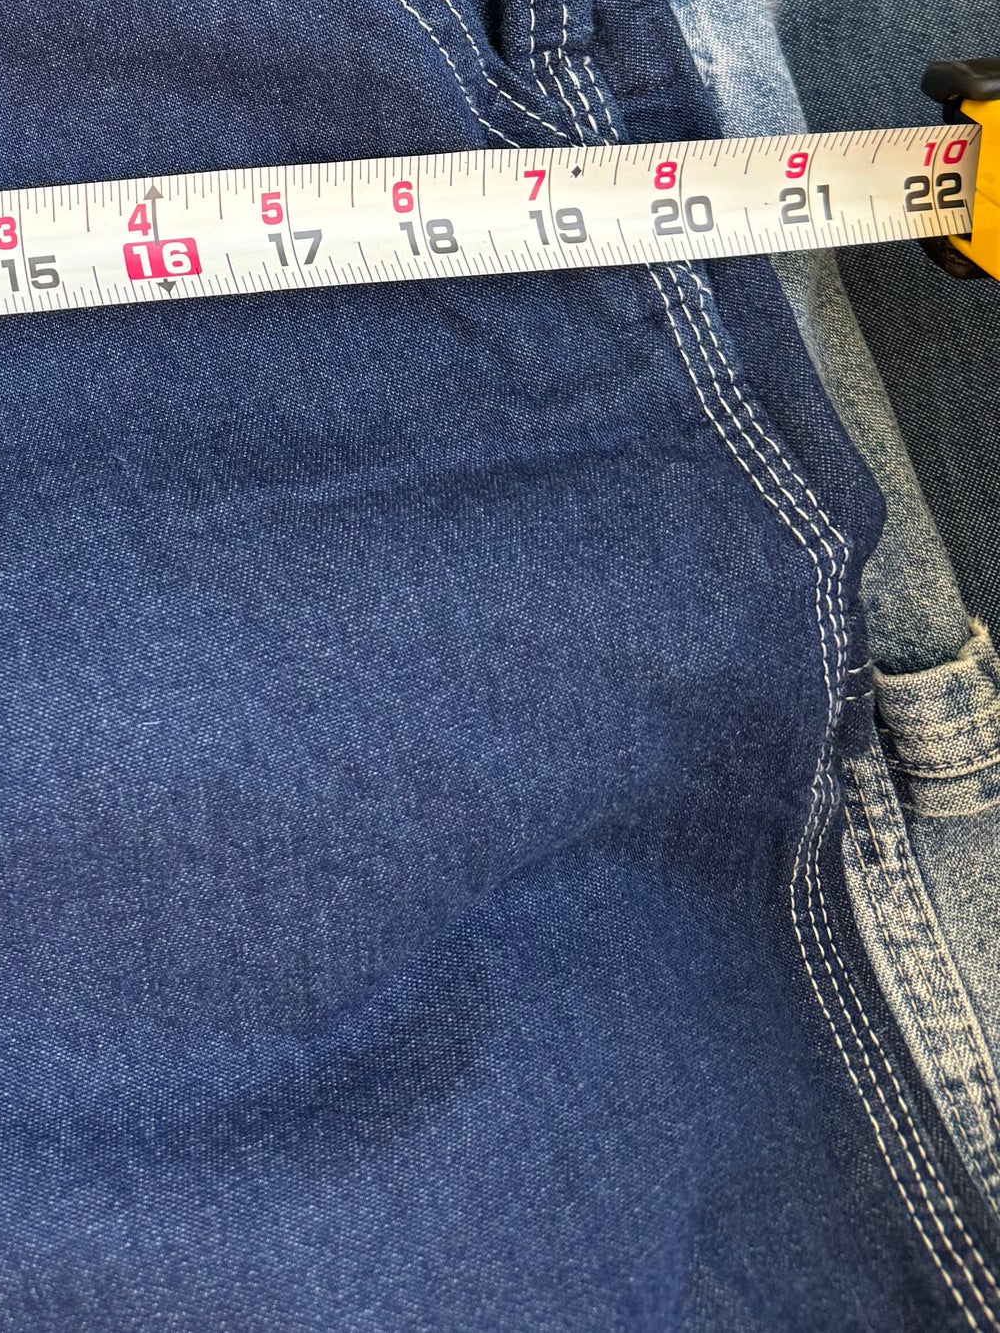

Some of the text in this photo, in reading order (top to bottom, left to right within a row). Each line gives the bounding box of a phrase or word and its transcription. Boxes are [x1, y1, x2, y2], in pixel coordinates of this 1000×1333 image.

[1, 254, 60, 292] 15
[130, 243, 192, 277] 16
[267, 229, 323, 267] 17
[399, 218, 459, 256] 18
[528, 207, 588, 246] 19
[651, 195, 715, 236] 20
[778, 184, 833, 225] 21
[903, 172, 965, 213] 22
[127, 203, 152, 236] 4
[260, 191, 283, 225] 5
[392, 180, 414, 213] 6
[523, 169, 546, 201] 7
[653, 161, 678, 190] 8
[785, 151, 809, 179] 9
[923, 139, 968, 167] 10
